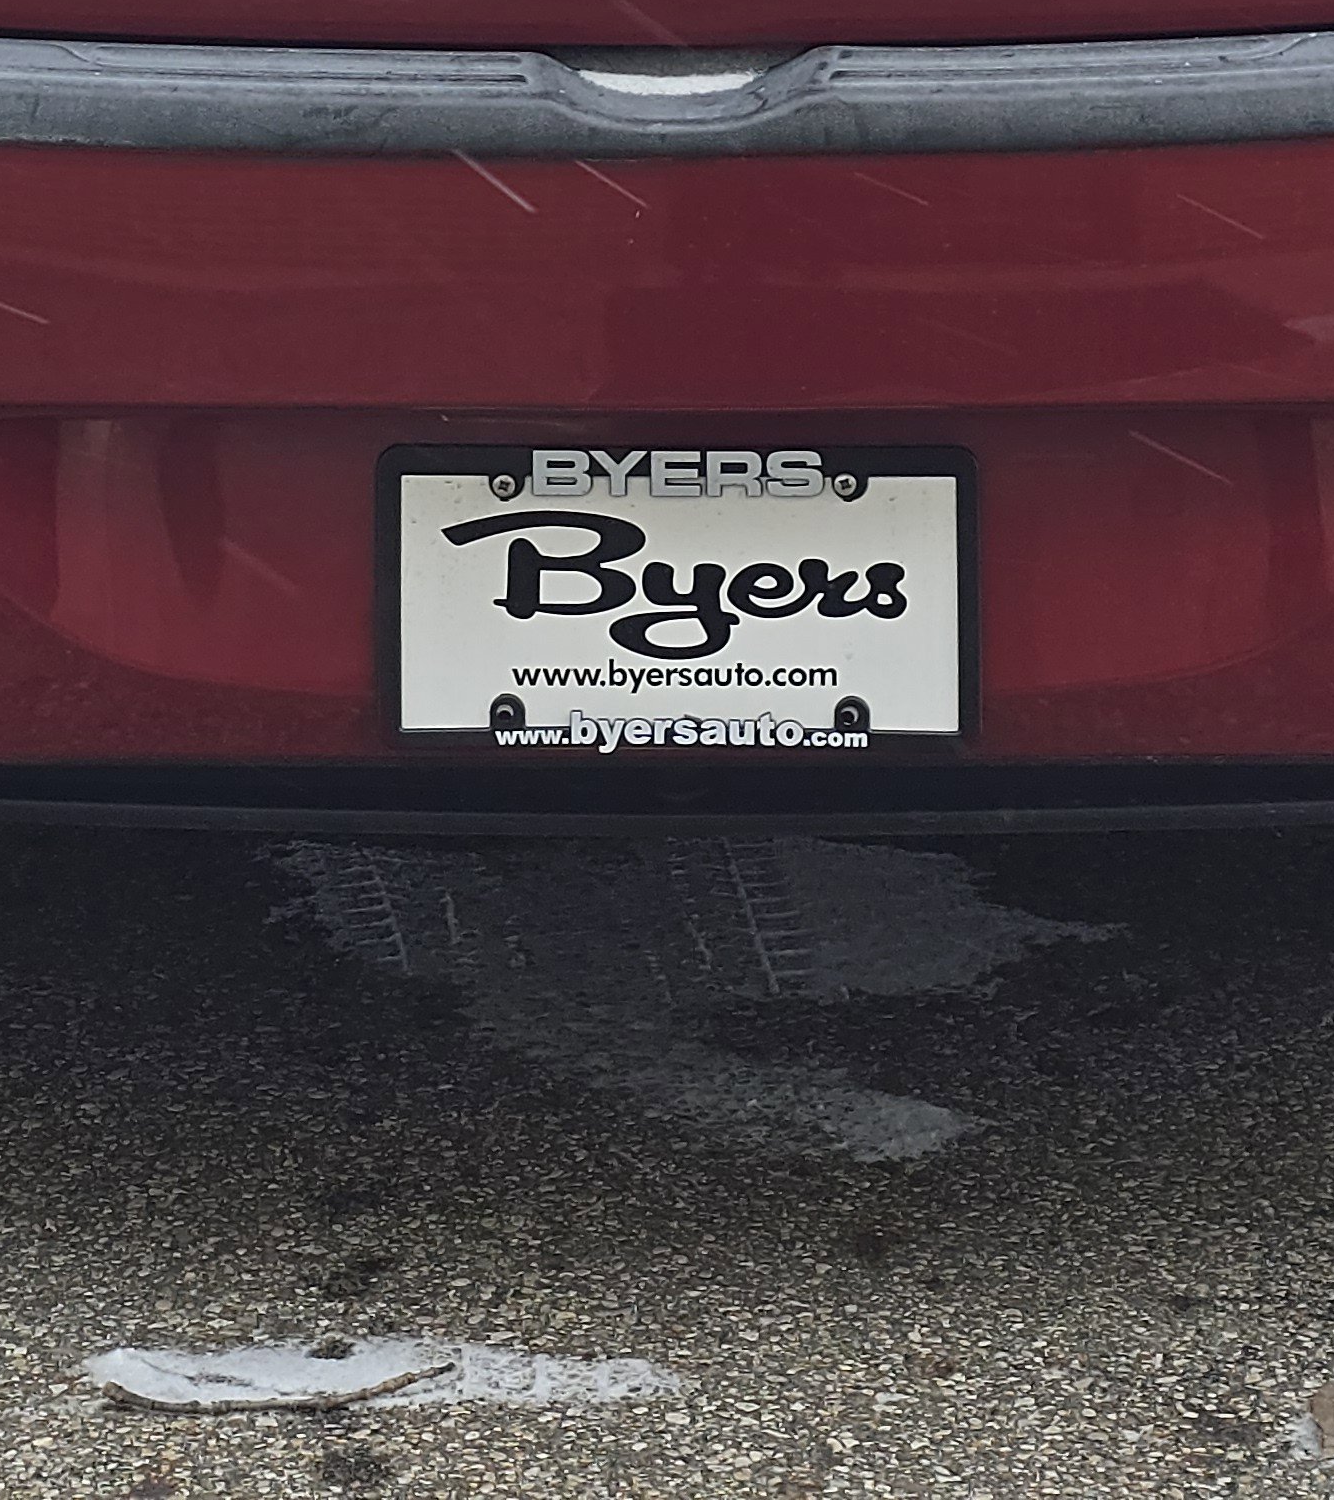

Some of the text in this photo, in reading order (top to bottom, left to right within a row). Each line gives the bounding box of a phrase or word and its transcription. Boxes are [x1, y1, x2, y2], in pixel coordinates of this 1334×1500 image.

[531, 449, 824, 497] BYERS
[441, 510, 907, 660] Byers
[513, 659, 838, 694] www.byersauto.com
[495, 711, 869, 754] www.byersauto.com
